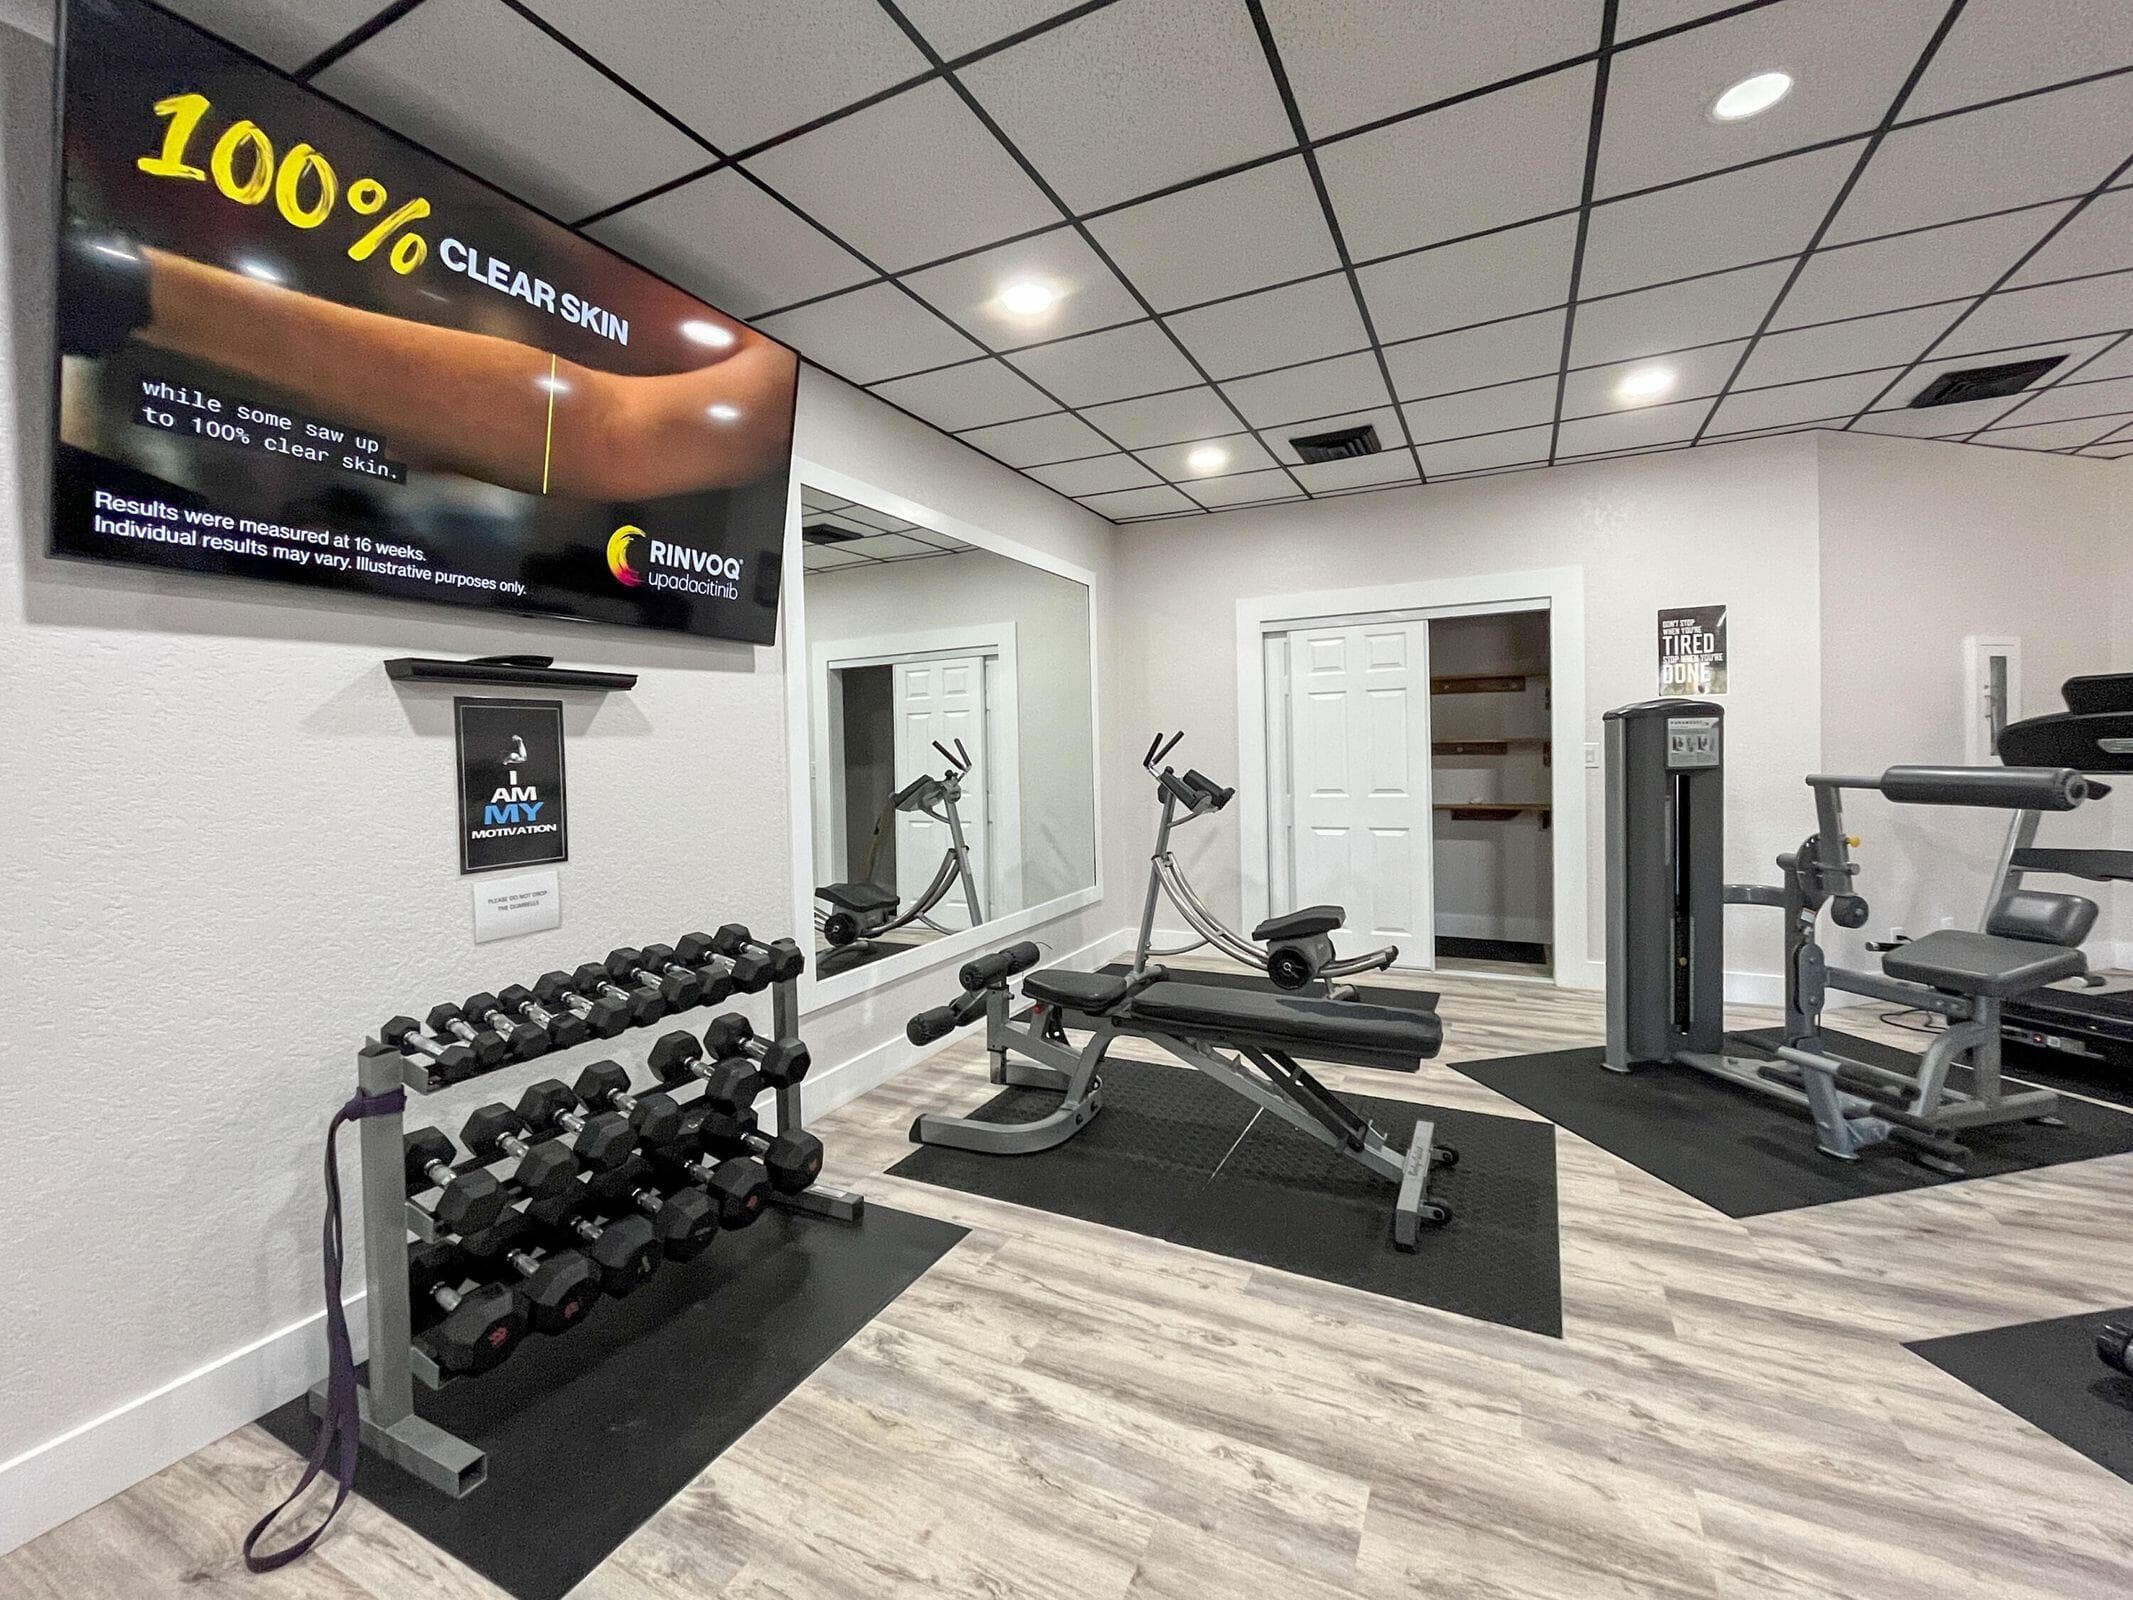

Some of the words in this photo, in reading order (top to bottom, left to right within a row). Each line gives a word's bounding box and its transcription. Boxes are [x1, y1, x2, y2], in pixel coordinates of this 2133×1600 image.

[137, 93, 431, 275] 100%
[439, 238, 556, 314] CLEAR
[559, 293, 629, 346] SKIN
[142, 381, 222, 413] while
[236, 404, 293, 430] some
[305, 422, 345, 443] saw
[355, 435, 379, 453] up
[142, 406, 174, 428] to
[191, 417, 250, 445] 100%
[264, 437, 330, 462] clear
[342, 455, 398, 479] skin.
[94, 490, 179, 521] Results
[184, 510, 235, 530] were
[239, 519, 329, 545] measured
[333, 534, 350, 549] at
[354, 536, 372, 552] 16
[375, 542, 427, 561] weeks.
[94, 515, 196, 546] Individual
[202, 534, 268, 557] results
[273, 546, 310, 566] may
[314, 551, 352, 571] vary.
[356, 556, 432, 581] Illustrative
[435, 571, 497, 588] purposes
[499, 580, 528, 596] only.
[648, 571, 738, 600] upadacitinib
[1662, 633, 1714, 656] TIRED
[1662, 662, 1711, 684] DONE
[509, 770, 517, 785] I
[491, 786, 538, 804] AM
[484, 801, 544, 825] MY
[471, 824, 557, 840] MOTIVATION
